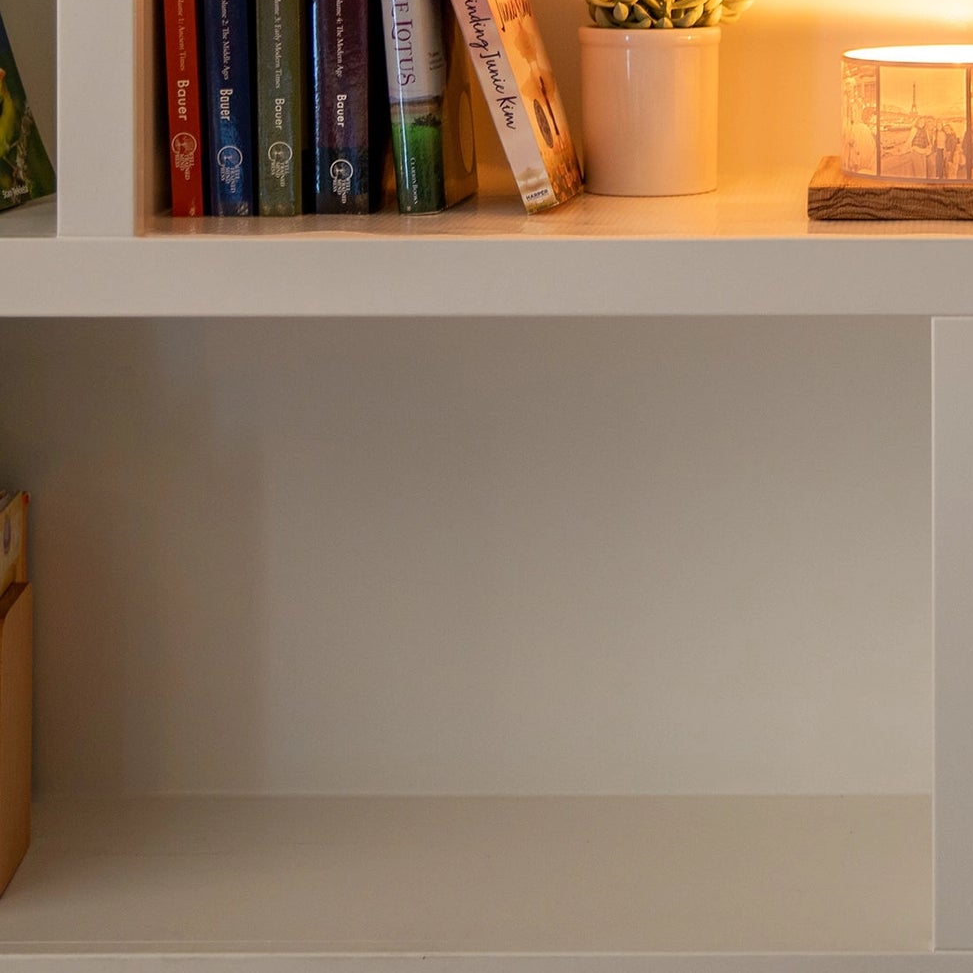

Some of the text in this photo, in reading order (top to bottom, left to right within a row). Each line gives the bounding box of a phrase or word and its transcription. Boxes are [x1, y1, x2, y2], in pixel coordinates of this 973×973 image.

[222, 28, 230, 39] The
[273, 25, 281, 41] Early
[274, 43, 282, 68] Modern
[337, 38, 345, 63] Modern
[391, 20, 416, 87] LOTUS
[335, 65, 344, 77] Age
[177, 79, 190, 121] Bauer
[220, 88, 234, 121] Bauer
[480, 51, 506, 94] Junie
[496, 96, 517, 129] Kim
[275, 98, 285, 129] Bauer
[337, 94, 347, 127] Bauer
